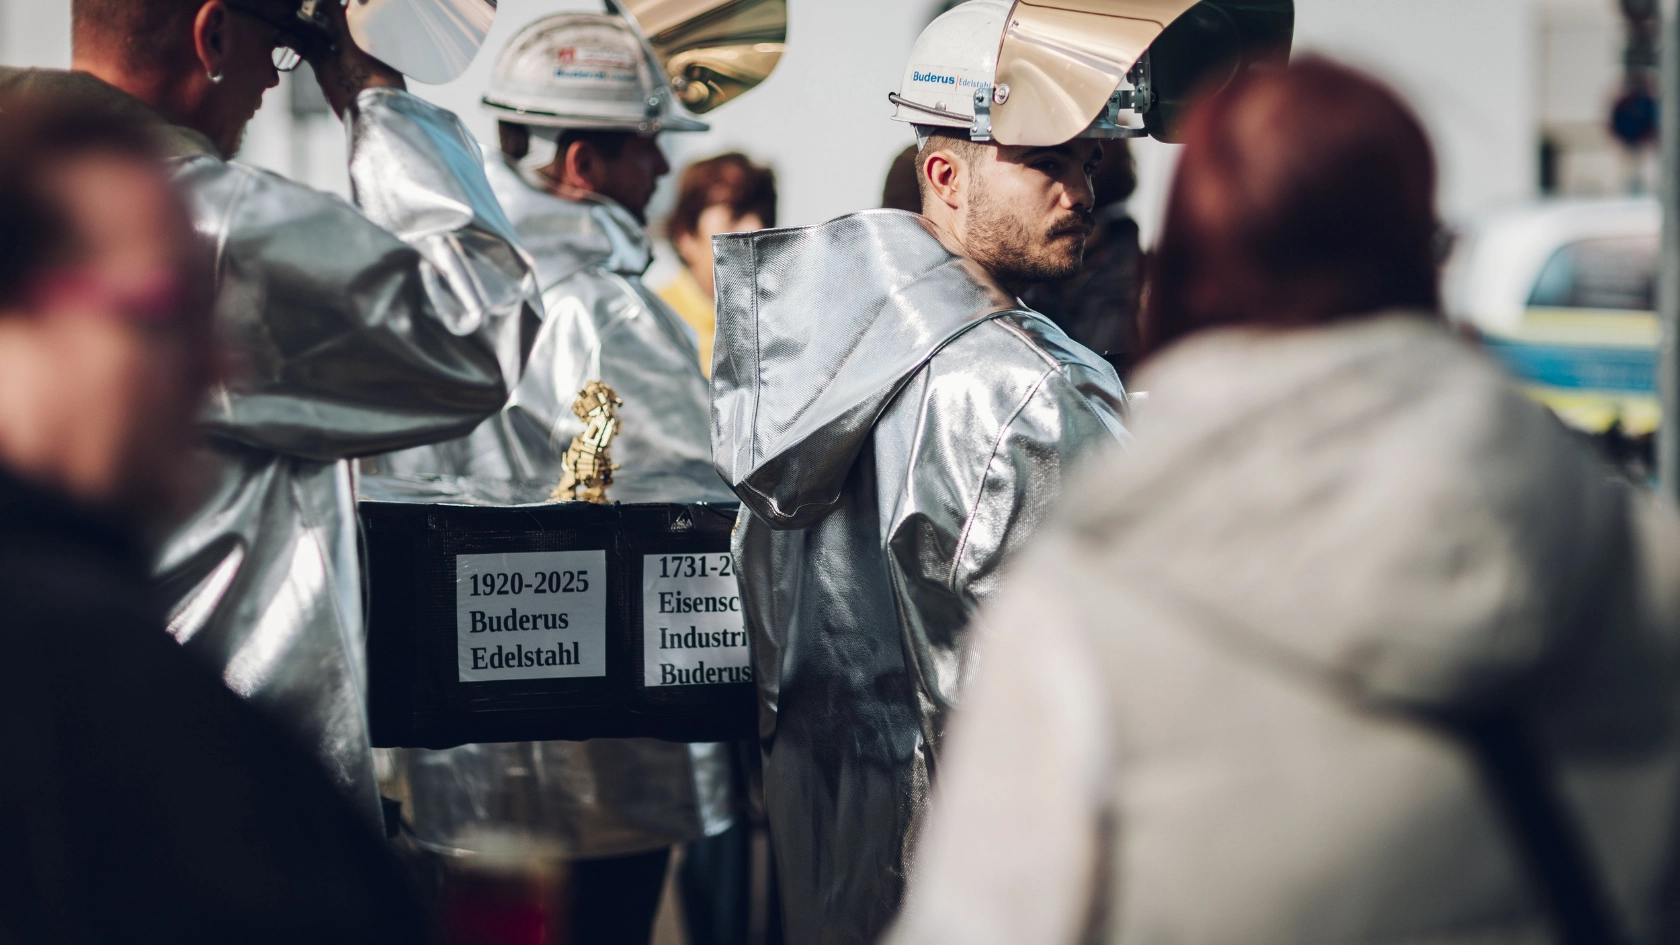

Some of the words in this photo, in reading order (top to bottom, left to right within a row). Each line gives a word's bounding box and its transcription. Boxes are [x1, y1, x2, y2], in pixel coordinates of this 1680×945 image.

[913, 71, 955, 84] Buderus
[958, 78, 991, 88] Edelstahl
[469, 570, 589, 596] 1920-2025
[658, 590, 742, 614] Eisensc
[469, 608, 569, 633] Buderus
[470, 641, 580, 670] Edelstahl
[660, 660, 752, 685] Buderus
